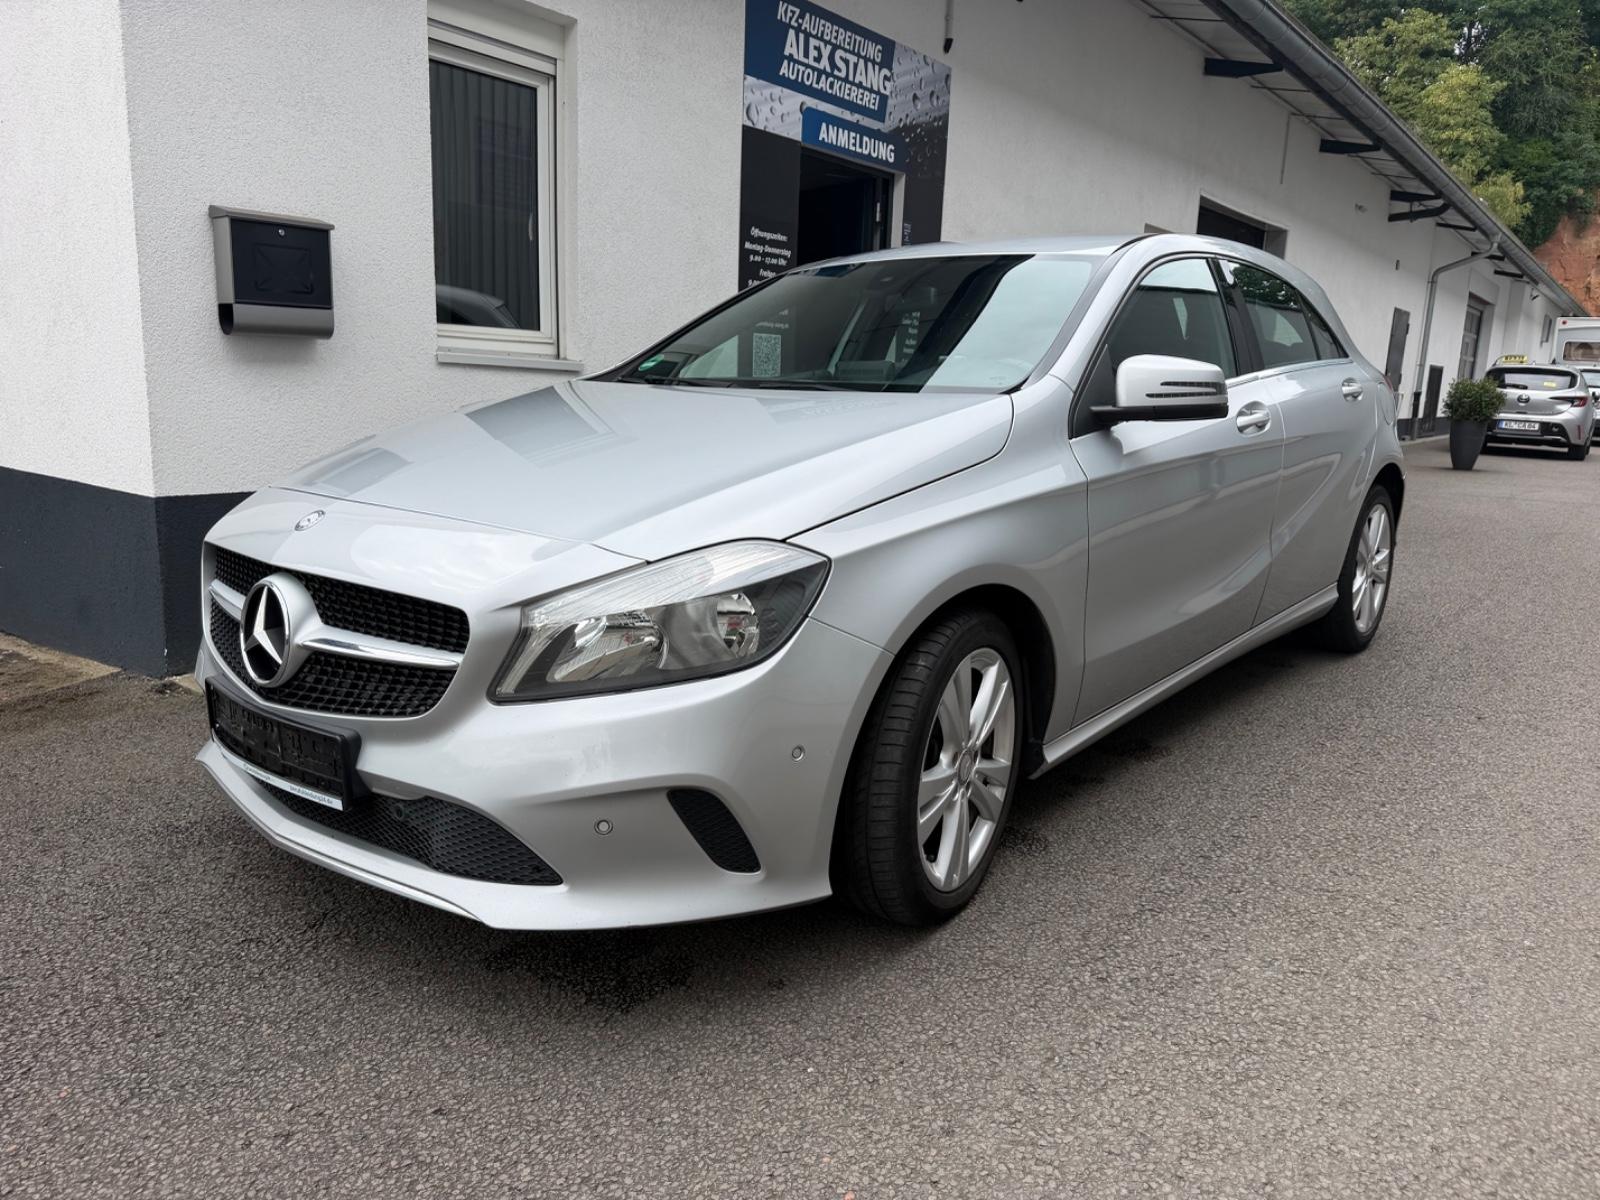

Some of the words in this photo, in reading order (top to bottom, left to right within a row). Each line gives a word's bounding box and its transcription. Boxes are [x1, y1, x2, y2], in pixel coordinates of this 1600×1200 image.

[777, 1, 882, 62] KFZ-AUFBEREITUNG
[779, 60, 880, 110] AUTOLACKIEREREI
[784, 29, 831, 73] ALEX
[834, 51, 893, 94] STANG
[819, 122, 895, 163] ANMELDUNG
